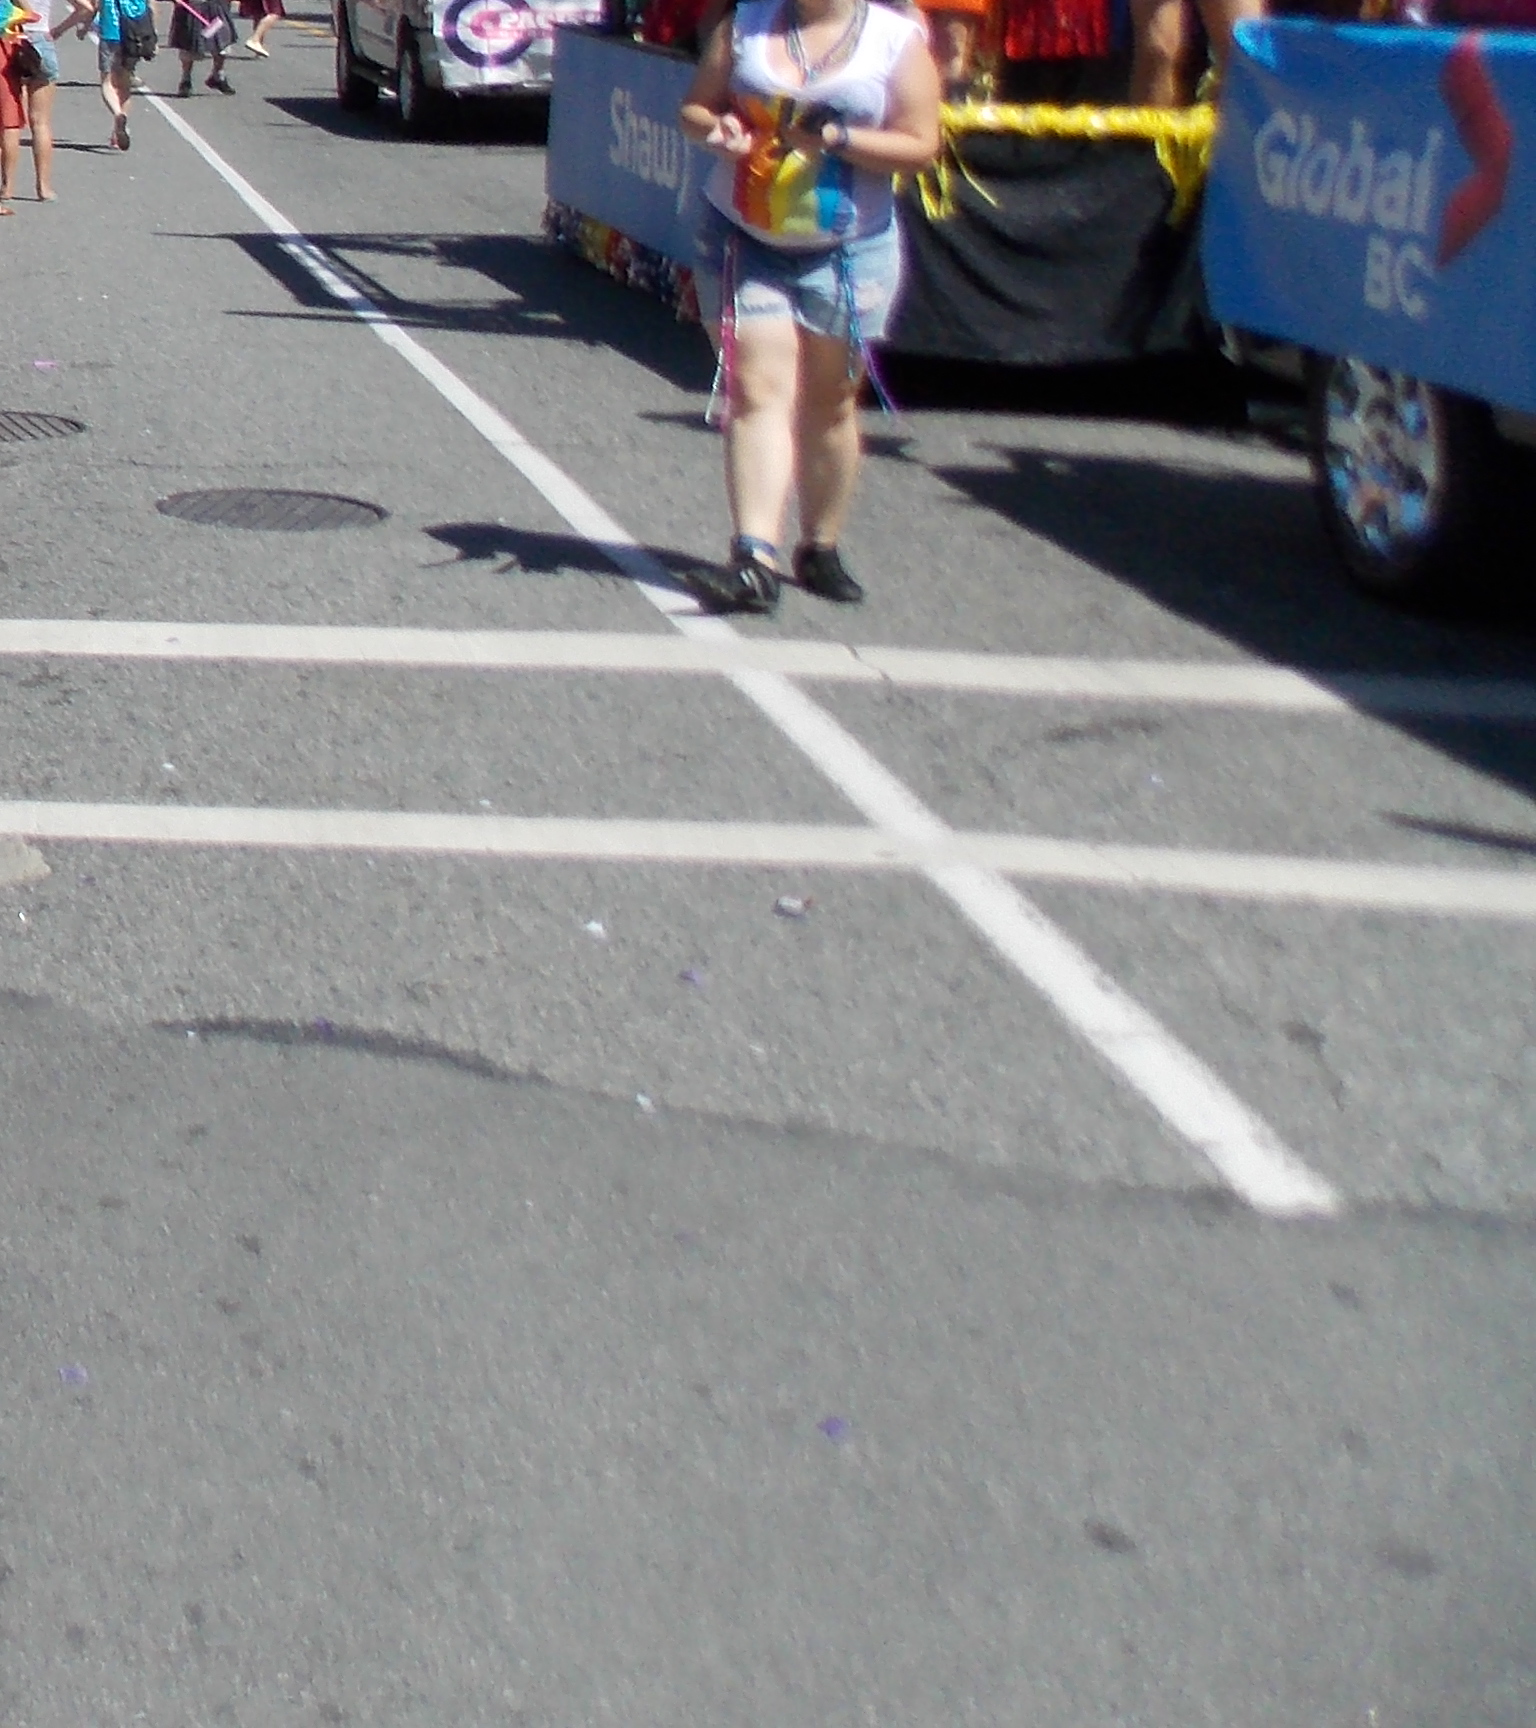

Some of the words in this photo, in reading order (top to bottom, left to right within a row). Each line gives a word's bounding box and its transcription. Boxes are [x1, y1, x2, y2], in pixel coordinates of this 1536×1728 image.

[610, 87, 678, 190] Shaw
[1254, 110, 1443, 232] Global
[1365, 236, 1432, 319] BC
